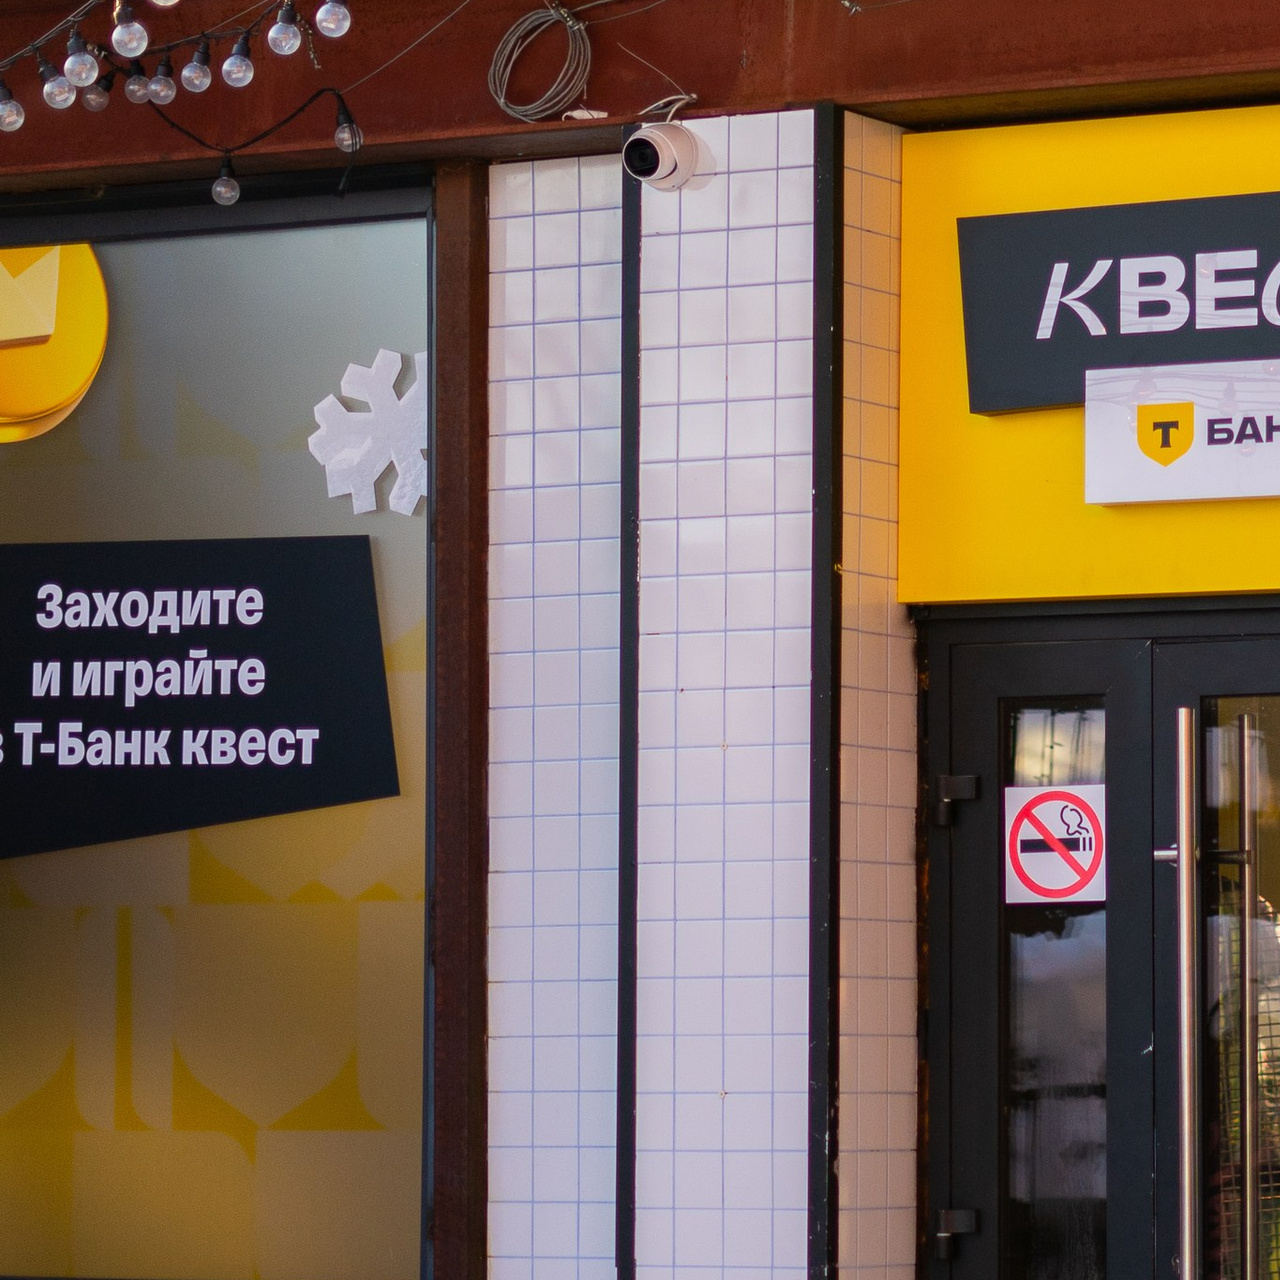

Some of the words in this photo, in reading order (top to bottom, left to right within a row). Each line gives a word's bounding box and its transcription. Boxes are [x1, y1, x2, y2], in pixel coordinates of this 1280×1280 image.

[36, 584, 264, 634] Заходите
[32, 662, 61, 697] и
[72, 649, 266, 708] играйте
[14, 722, 171, 766] Т-Банк
[182, 728, 320, 766] квест
